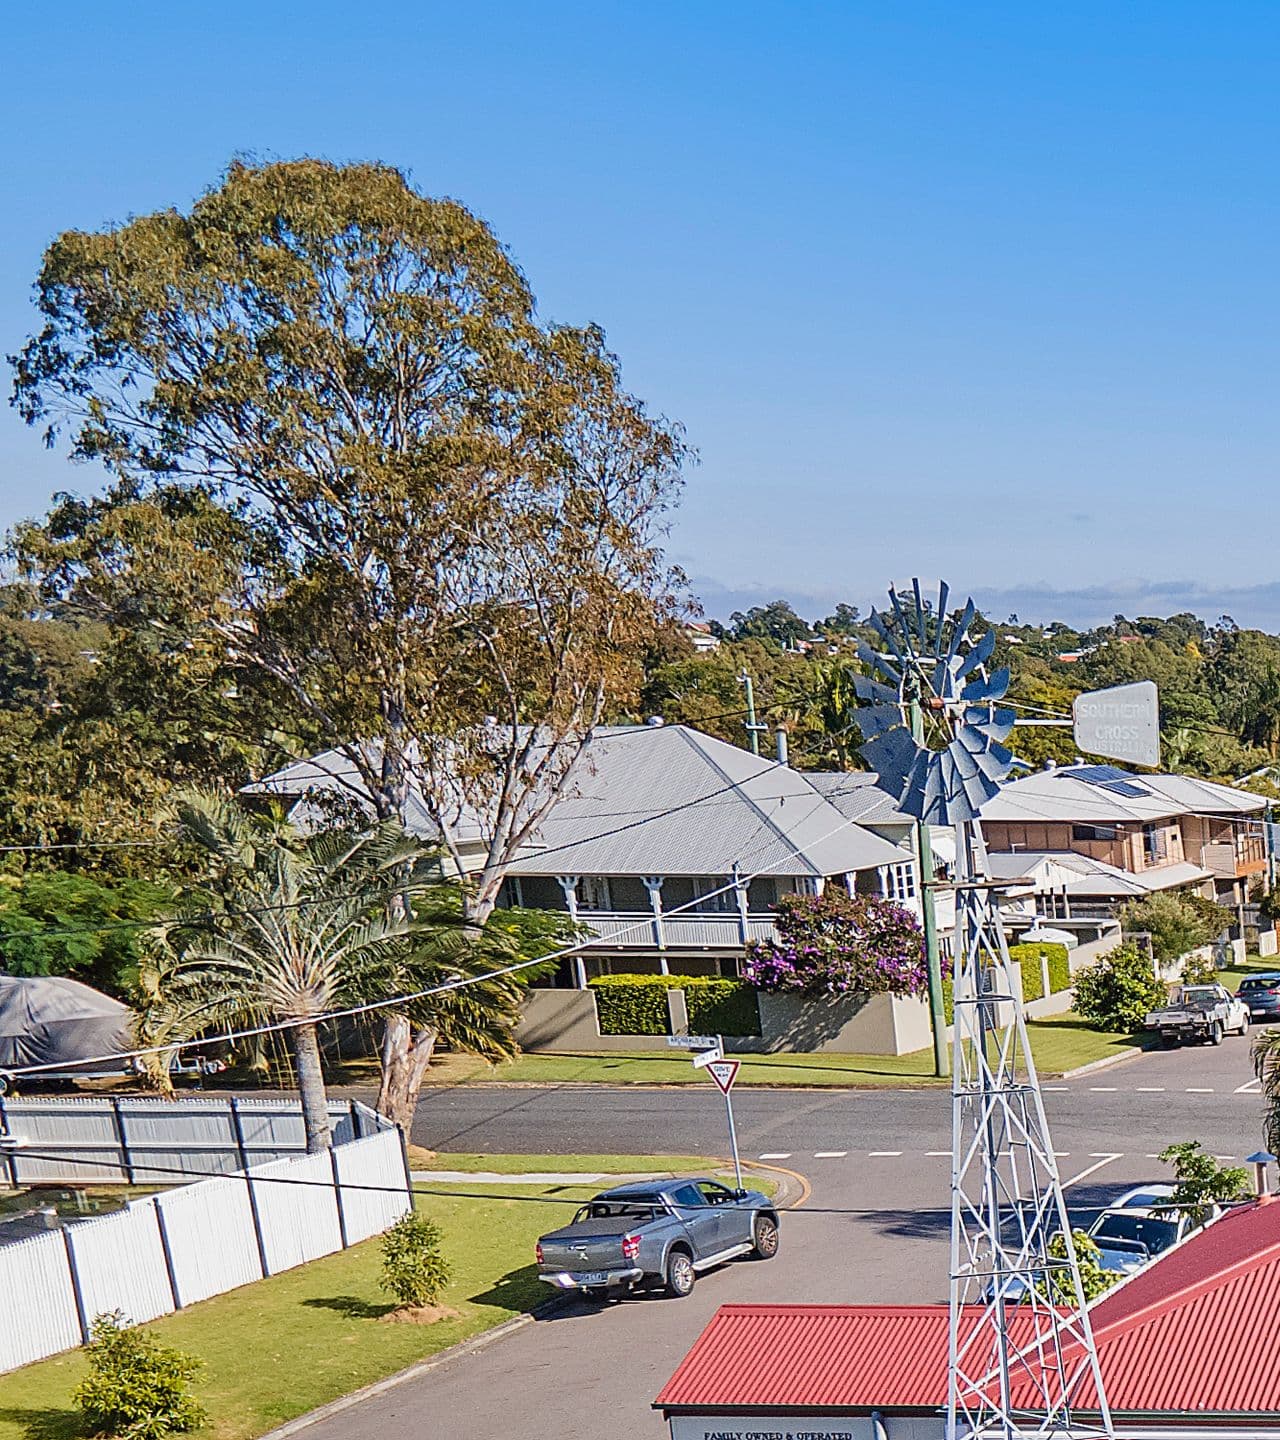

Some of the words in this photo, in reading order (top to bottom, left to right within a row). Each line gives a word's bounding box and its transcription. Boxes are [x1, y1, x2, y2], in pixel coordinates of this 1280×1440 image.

[1095, 726, 1138, 739] CROSS
[704, 1432, 743, 1440] FAMILY
[745, 1432, 783, 1440] OWNED
[786, 1432, 793, 1440] &
[797, 1432, 853, 1440] OPERATED
